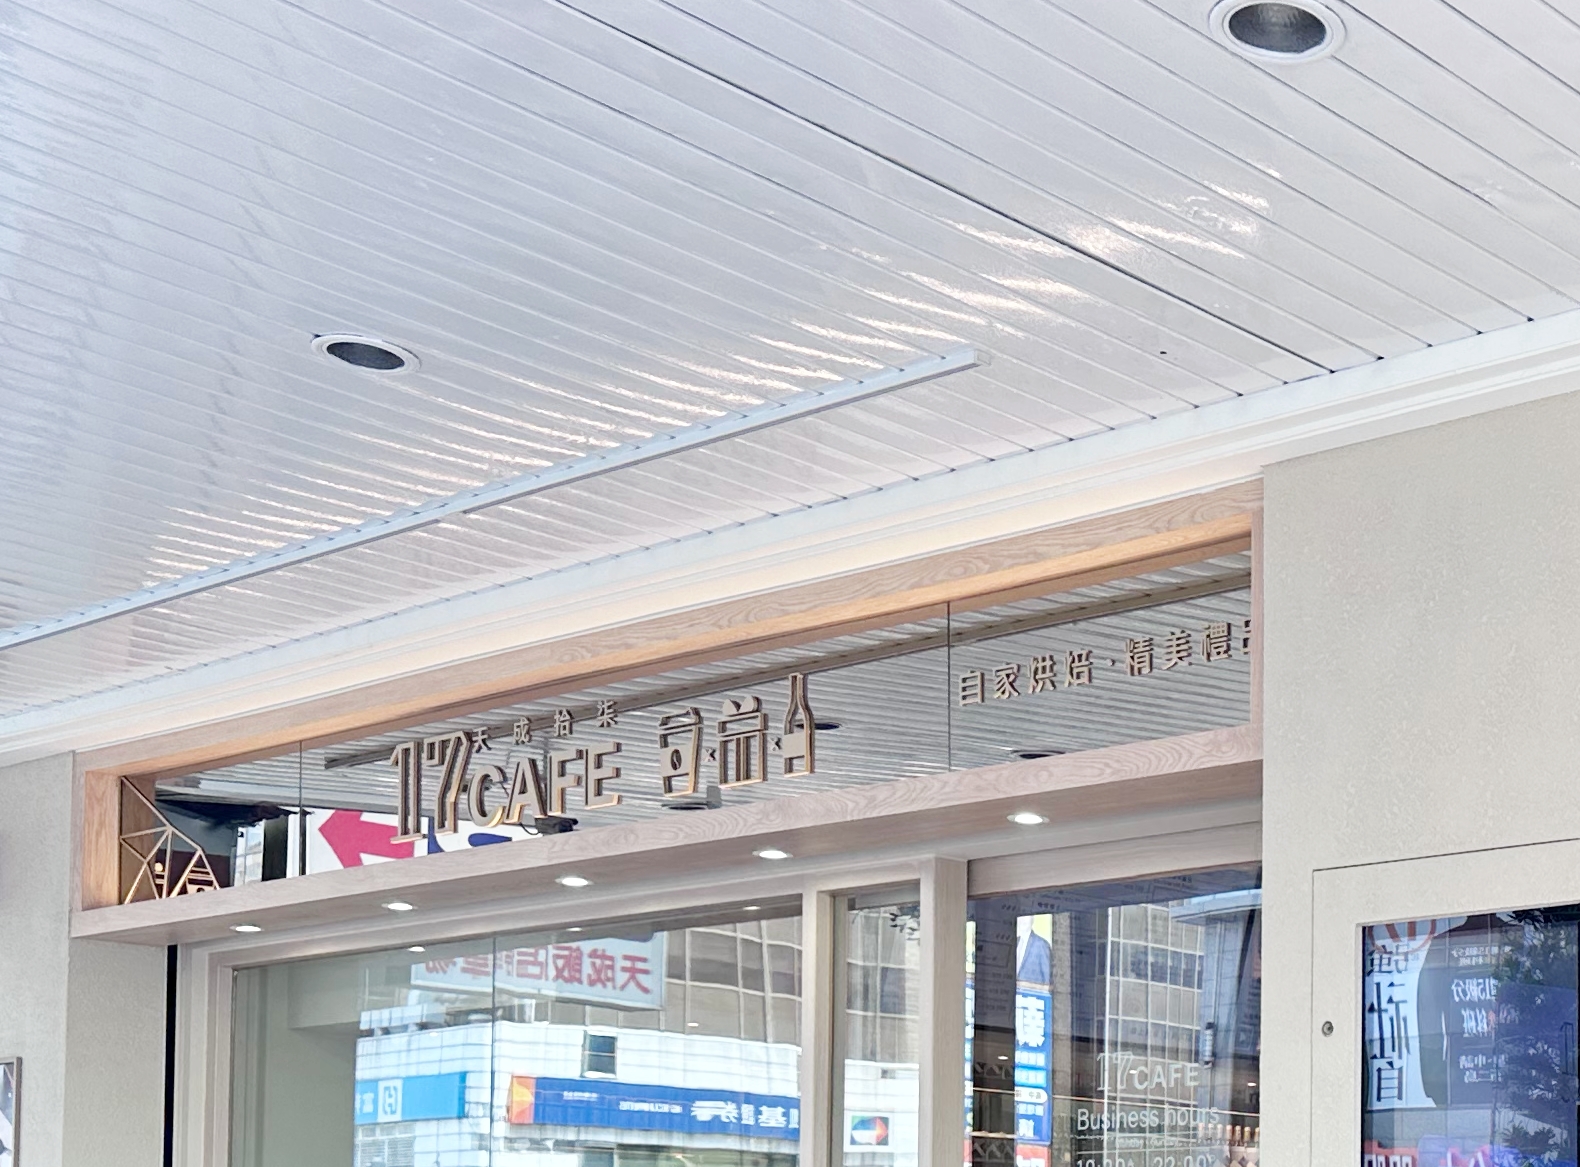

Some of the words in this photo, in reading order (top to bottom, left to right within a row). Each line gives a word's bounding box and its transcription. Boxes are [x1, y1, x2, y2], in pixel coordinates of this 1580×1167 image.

[473, 699, 618, 752] 天成拾柒
[1077, 1105, 1159, 1131] Business
[1166, 1103, 1220, 1127] hours
